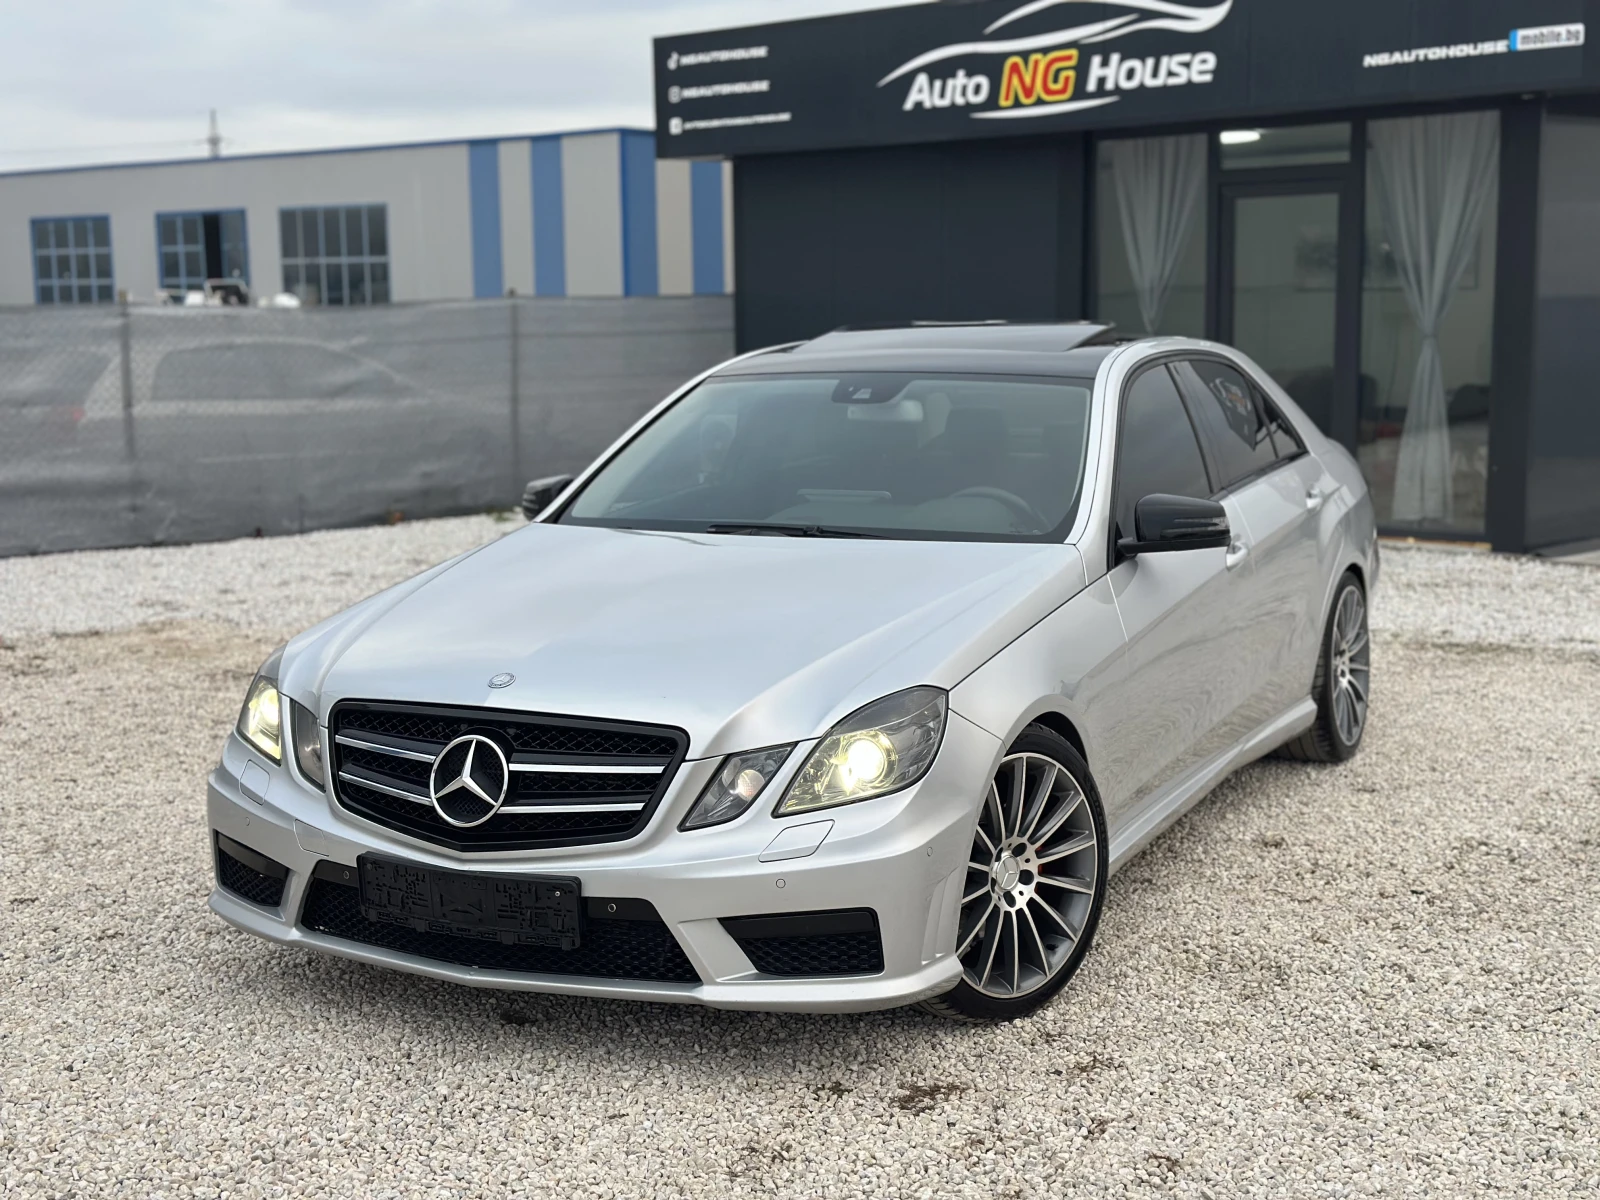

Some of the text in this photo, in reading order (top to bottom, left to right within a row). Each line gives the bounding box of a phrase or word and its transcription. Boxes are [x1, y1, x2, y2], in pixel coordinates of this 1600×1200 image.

[1363, 27, 1582, 68] NGAUTOHOUSE mobile.bg
[903, 48, 1217, 111] Auto NG House
